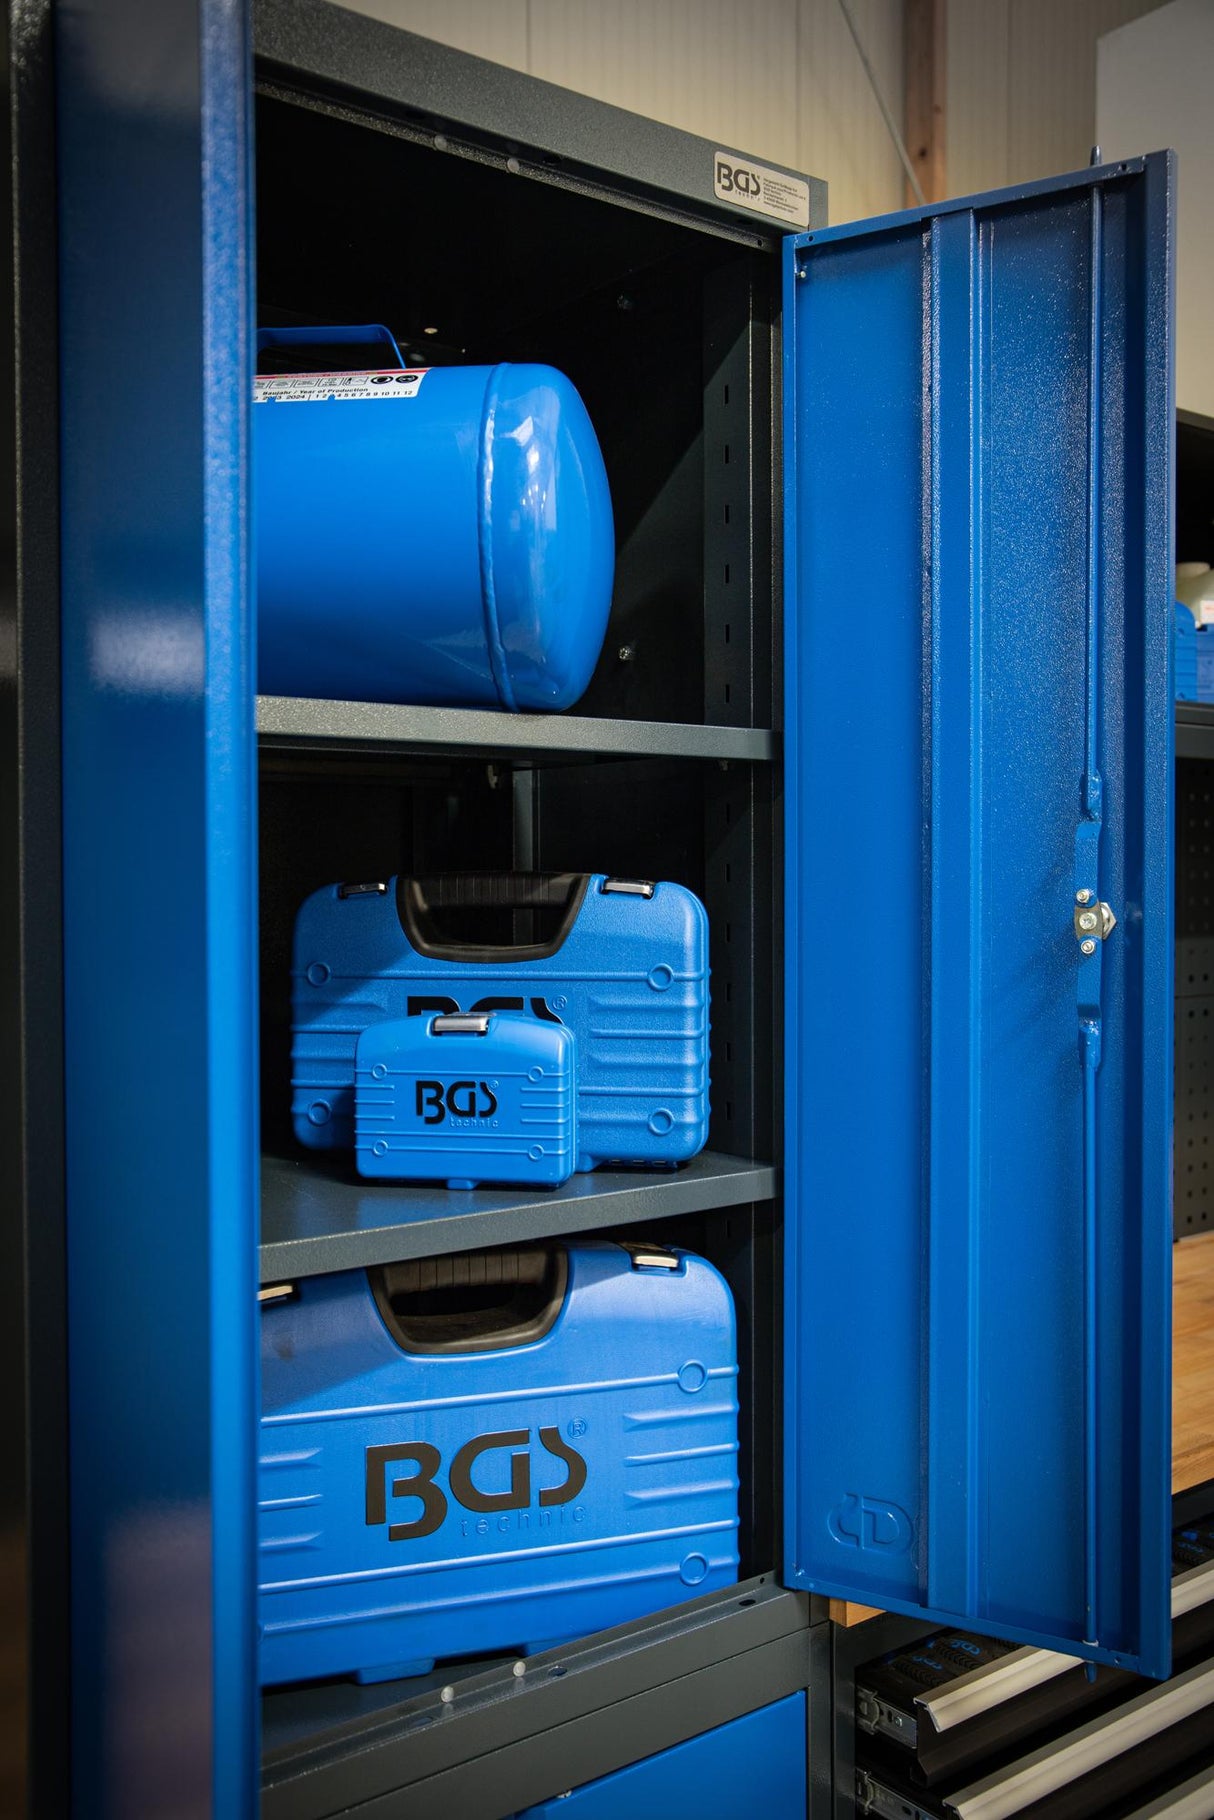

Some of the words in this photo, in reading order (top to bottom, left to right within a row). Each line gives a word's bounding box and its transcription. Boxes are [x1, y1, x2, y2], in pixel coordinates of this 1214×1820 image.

[717, 162, 761, 196] BGS
[415, 1080, 498, 1125] BGS
[449, 1118, 499, 1129] technic
[365, 1426, 588, 1542] BGS
[461, 1505, 588, 1537] technic
